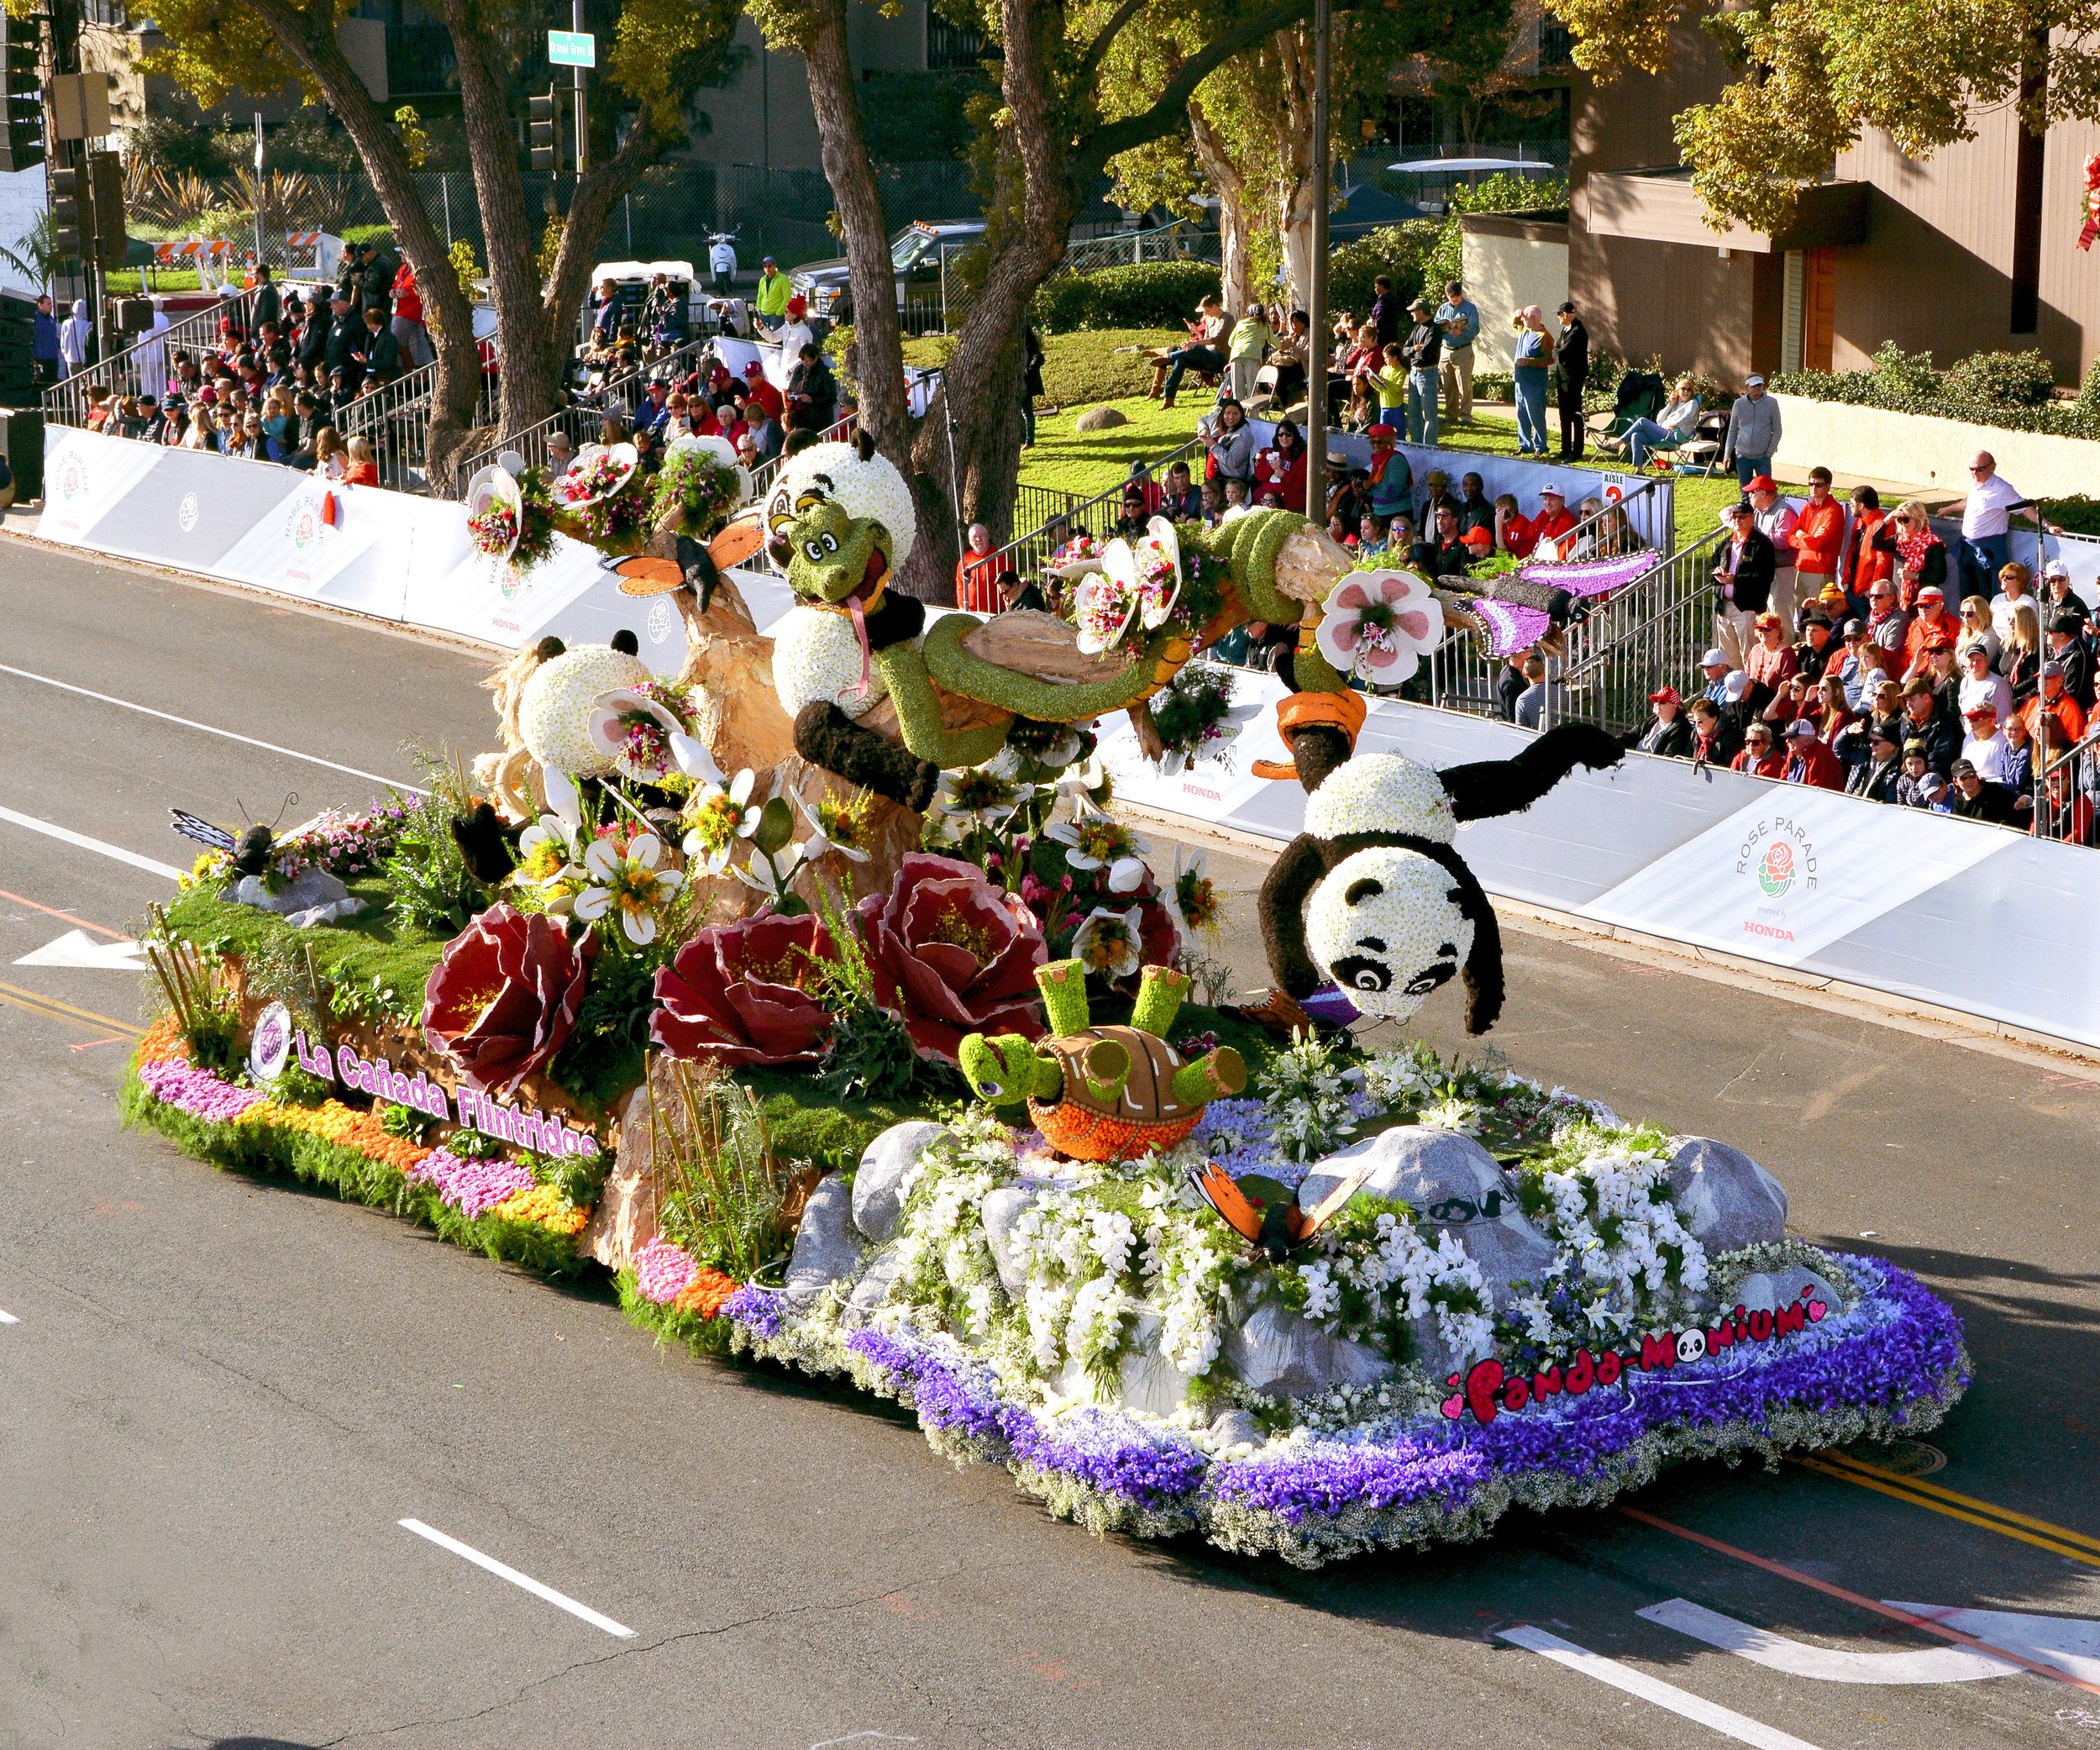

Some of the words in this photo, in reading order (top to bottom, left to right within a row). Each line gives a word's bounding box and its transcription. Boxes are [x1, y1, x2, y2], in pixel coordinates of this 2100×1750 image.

[550, 40, 569, 58] Orange
[570, 42, 586, 56] Grove
[1604, 474, 1624, 485] AISLE
[1510, 531, 1519, 541] 11
[286, 568, 311, 582] HONDA
[492, 617, 520, 633] HONDA
[1182, 783, 1222, 802] HONDA
[1736, 821, 1769, 875] ROSE
[1775, 817, 1818, 891] PARADE
[1756, 906, 1781, 917] presented
[1781, 908, 1788, 921] by
[1743, 921, 1795, 943] HONDA
[296, 1028, 334, 1082] La
[337, 1044, 450, 1121] Cañada
